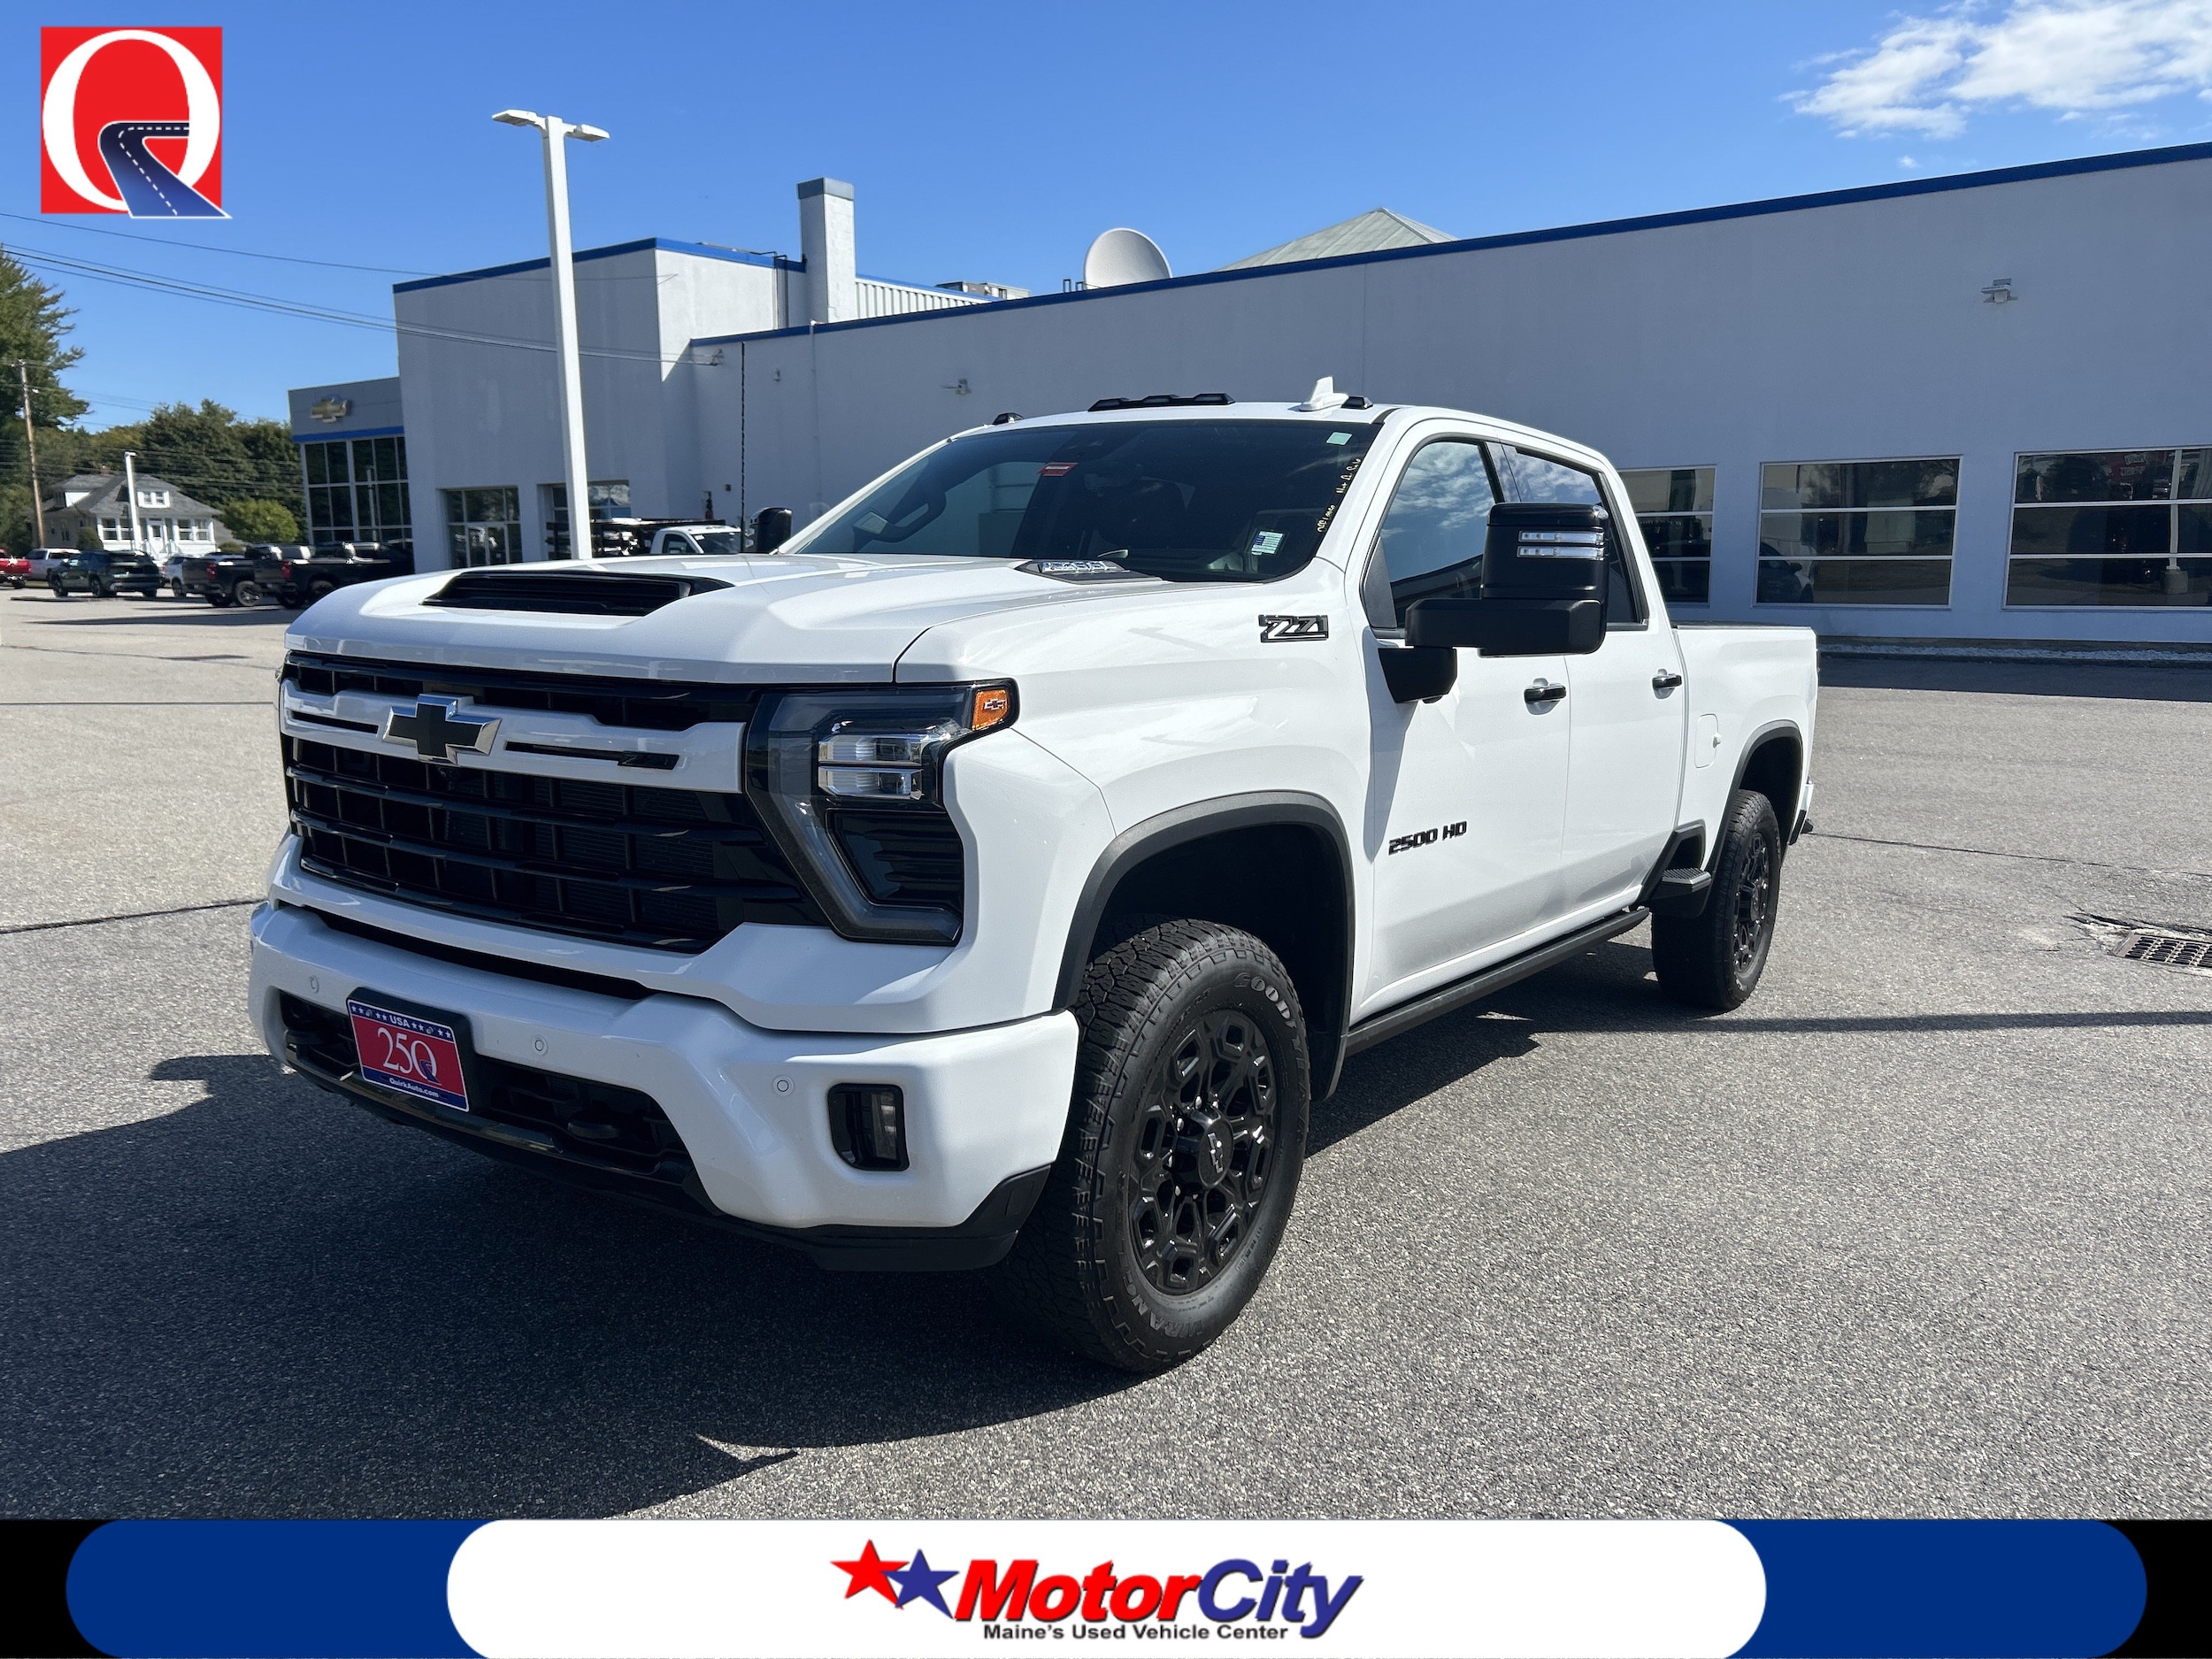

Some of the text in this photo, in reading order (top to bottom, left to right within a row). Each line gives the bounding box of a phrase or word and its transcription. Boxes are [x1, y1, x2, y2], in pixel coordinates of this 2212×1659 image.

[1258, 614, 1329, 643] Z71
[1388, 821, 1467, 856] 2500 HD
[388, 1015, 411, 1028] USA
[388, 1078, 439, 1098] QuirkAuto.com
